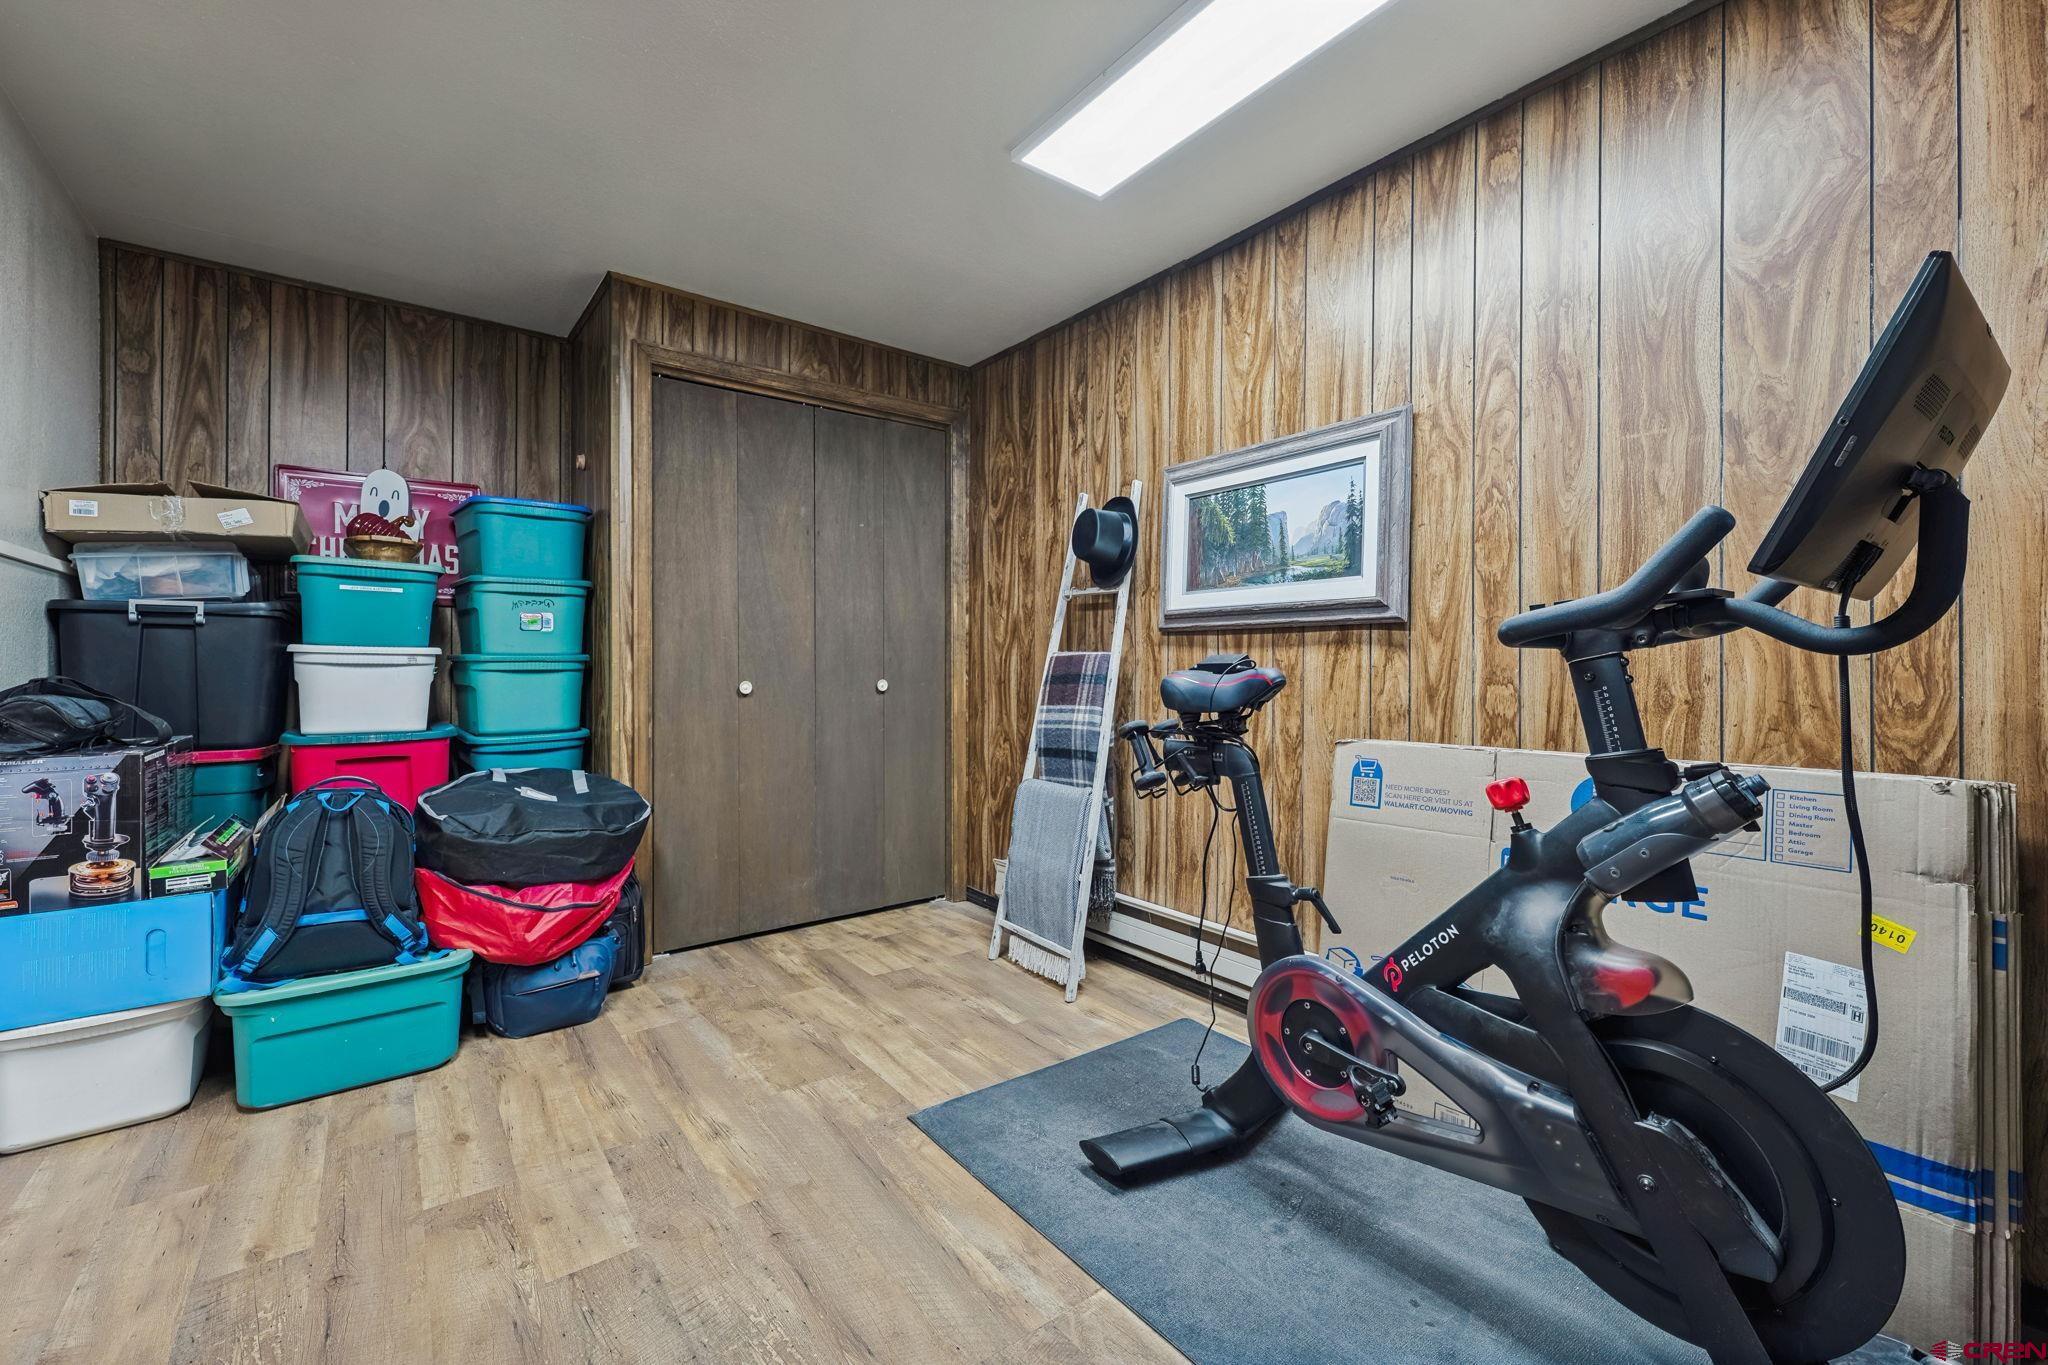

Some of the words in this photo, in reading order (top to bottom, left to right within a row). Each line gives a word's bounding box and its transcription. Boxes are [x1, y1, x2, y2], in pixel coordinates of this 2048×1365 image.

[1425, 788, 1450, 796] BOXES?
[1434, 797, 1451, 805] VISIT
[1384, 801, 1473, 816] WALMART.COM/MOVING
[1789, 803, 1810, 811] Living
[1789, 812, 1813, 820] Dining
[1789, 830, 1821, 838] Bedroom
[1788, 848, 1813, 856] Garage
[1401, 924, 1460, 972] PELOTON
